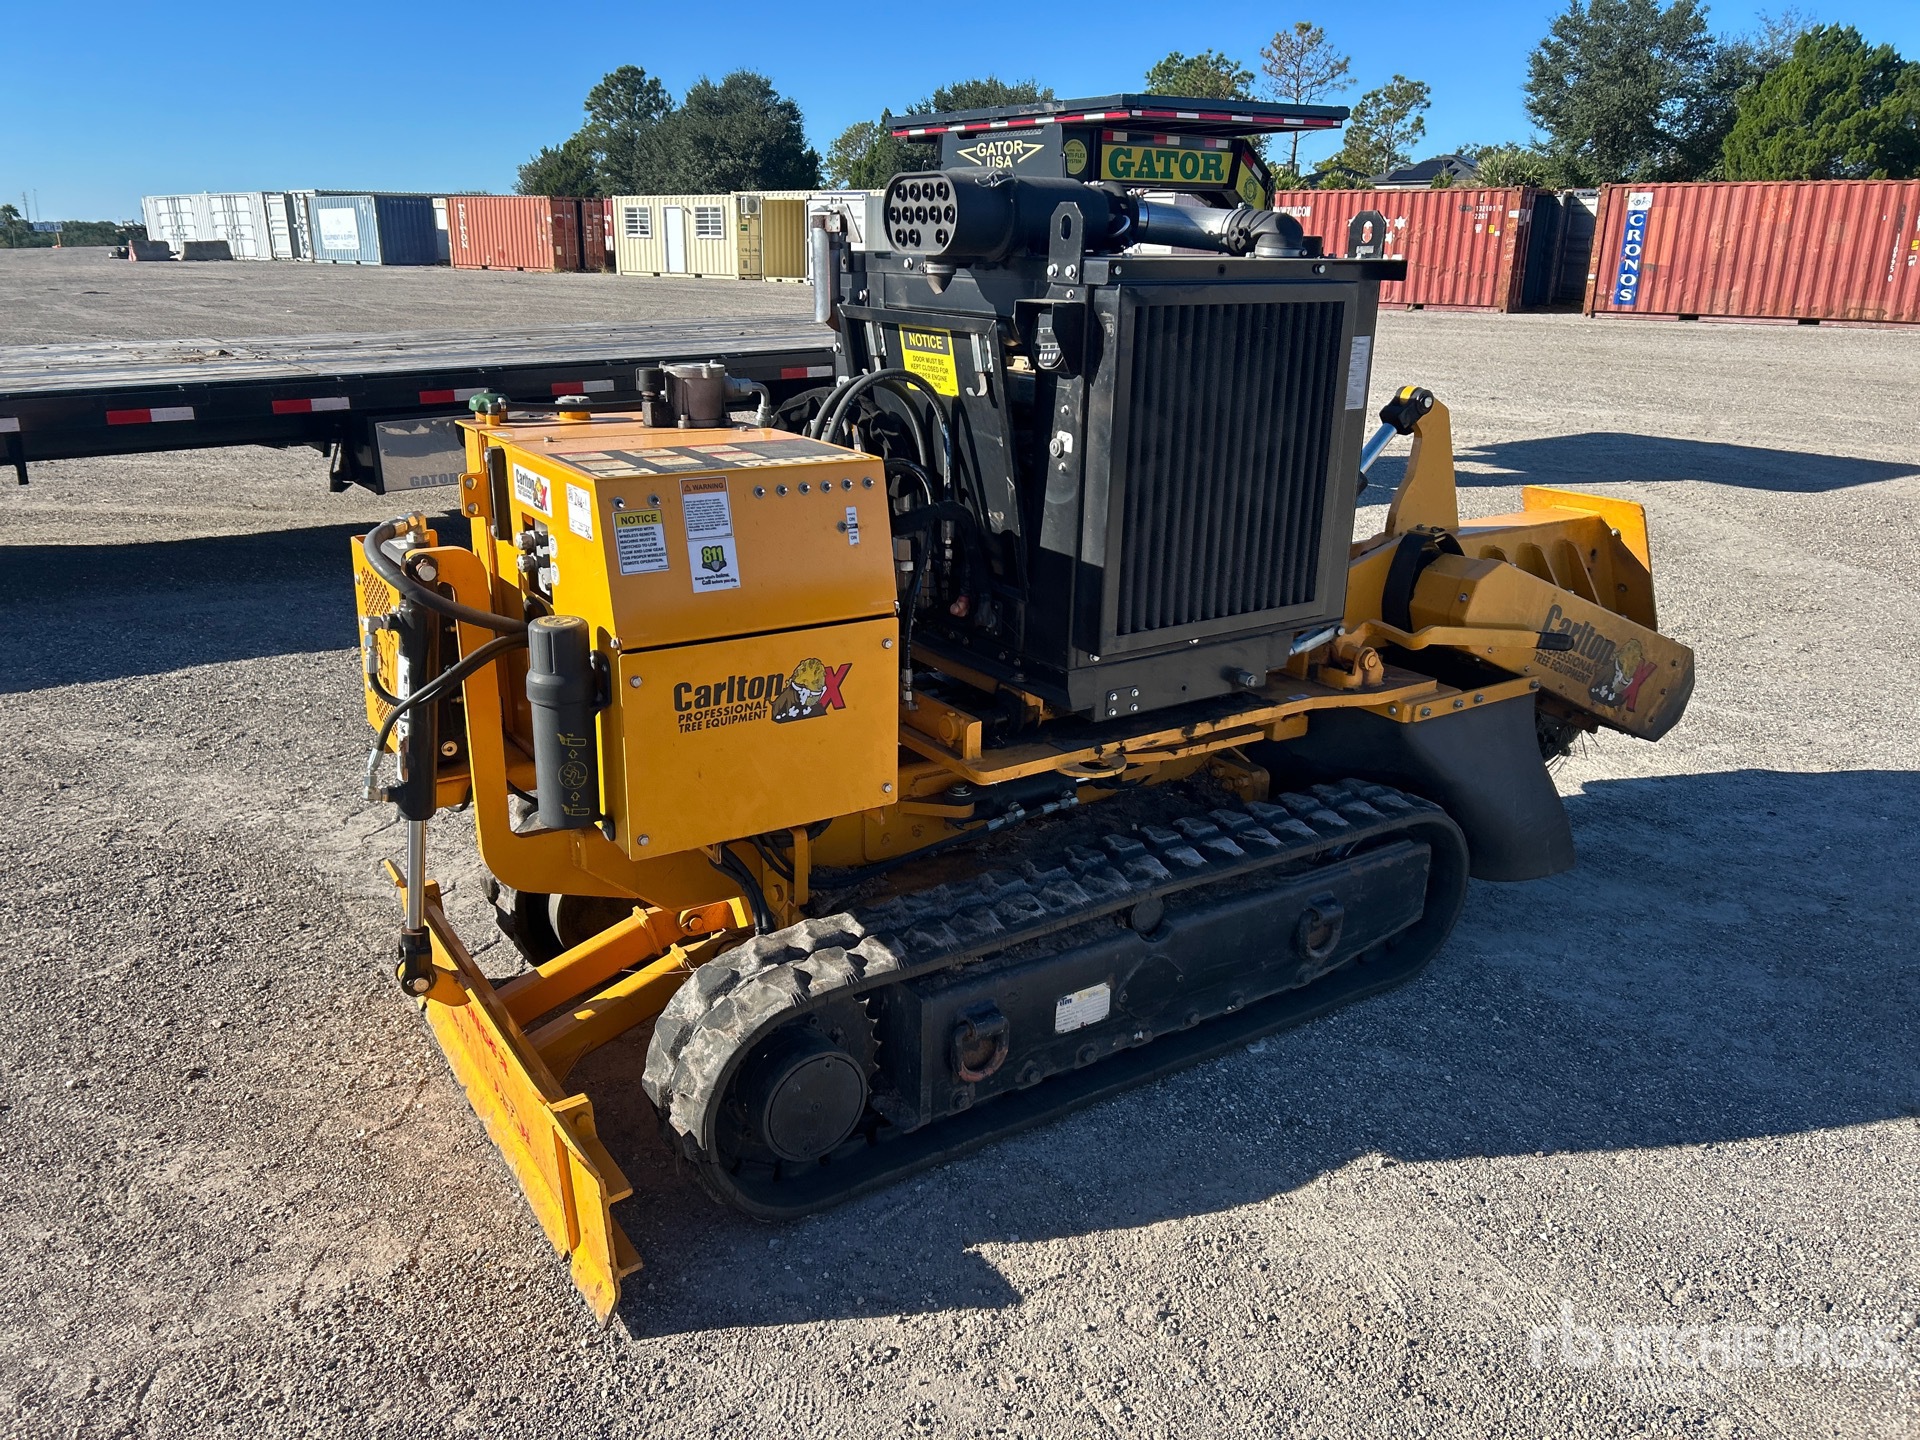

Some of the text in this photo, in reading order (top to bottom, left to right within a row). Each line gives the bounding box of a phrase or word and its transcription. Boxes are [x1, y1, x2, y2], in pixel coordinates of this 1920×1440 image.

[976, 140, 1023, 157] GATOR
[986, 156, 1013, 168] USA
[1108, 147, 1225, 182] GATOR
[458, 203, 468, 249] TRITON
[1620, 214, 1643, 301] CRONOS
[908, 332, 944, 350] NOTICE
[912, 355, 925, 363] DOOR
[925, 357, 937, 365] MUST
[922, 364, 939, 372] CLOSED
[409, 472, 459, 487] GATOR
[620, 514, 658, 525] NOTICE
[702, 545, 724, 563] 811
[1534, 651, 1591, 685] TREE EQUIPMENT
[1539, 649, 1595, 675] OFESSIONAL
[1541, 604, 1658, 712] Carlton X
[673, 662, 853, 713] Carlton X
[678, 701, 768, 724] PROFESSIONAL
[678, 710, 768, 734] TREE EQUIPMENT
